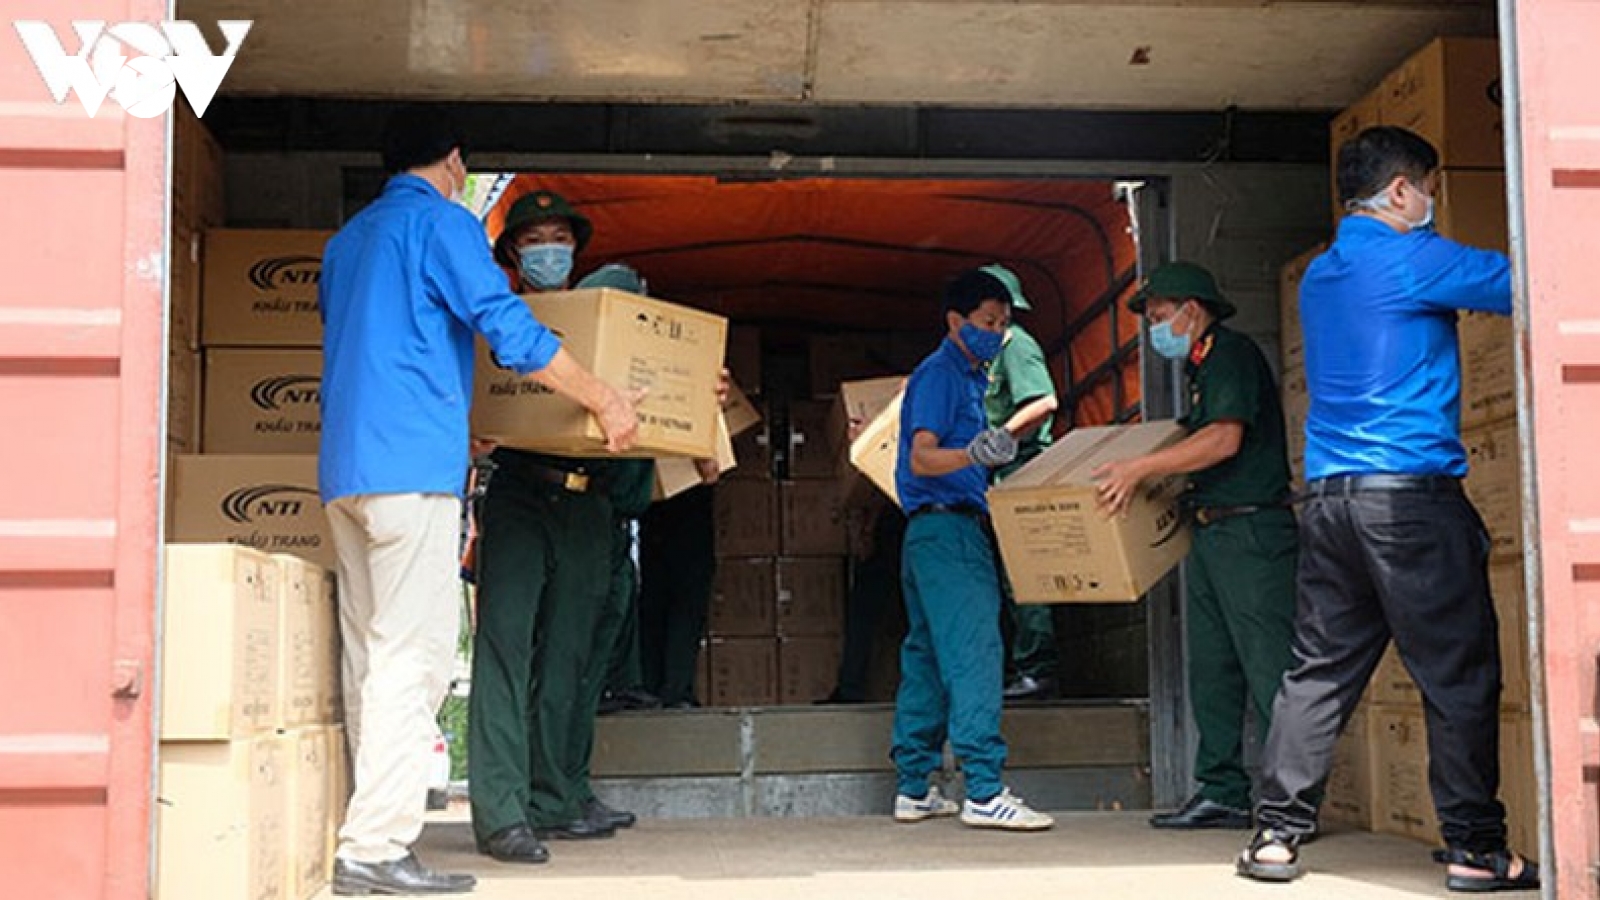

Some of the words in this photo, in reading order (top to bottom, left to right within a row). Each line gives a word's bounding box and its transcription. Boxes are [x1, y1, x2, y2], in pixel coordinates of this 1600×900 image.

[280, 270, 322, 284] NTI
[295, 301, 320, 312] TRA
[282, 390, 322, 403] NTI
[297, 421, 321, 432] TRA
[256, 501, 302, 515] NTI
[272, 534, 321, 548] TRANG
